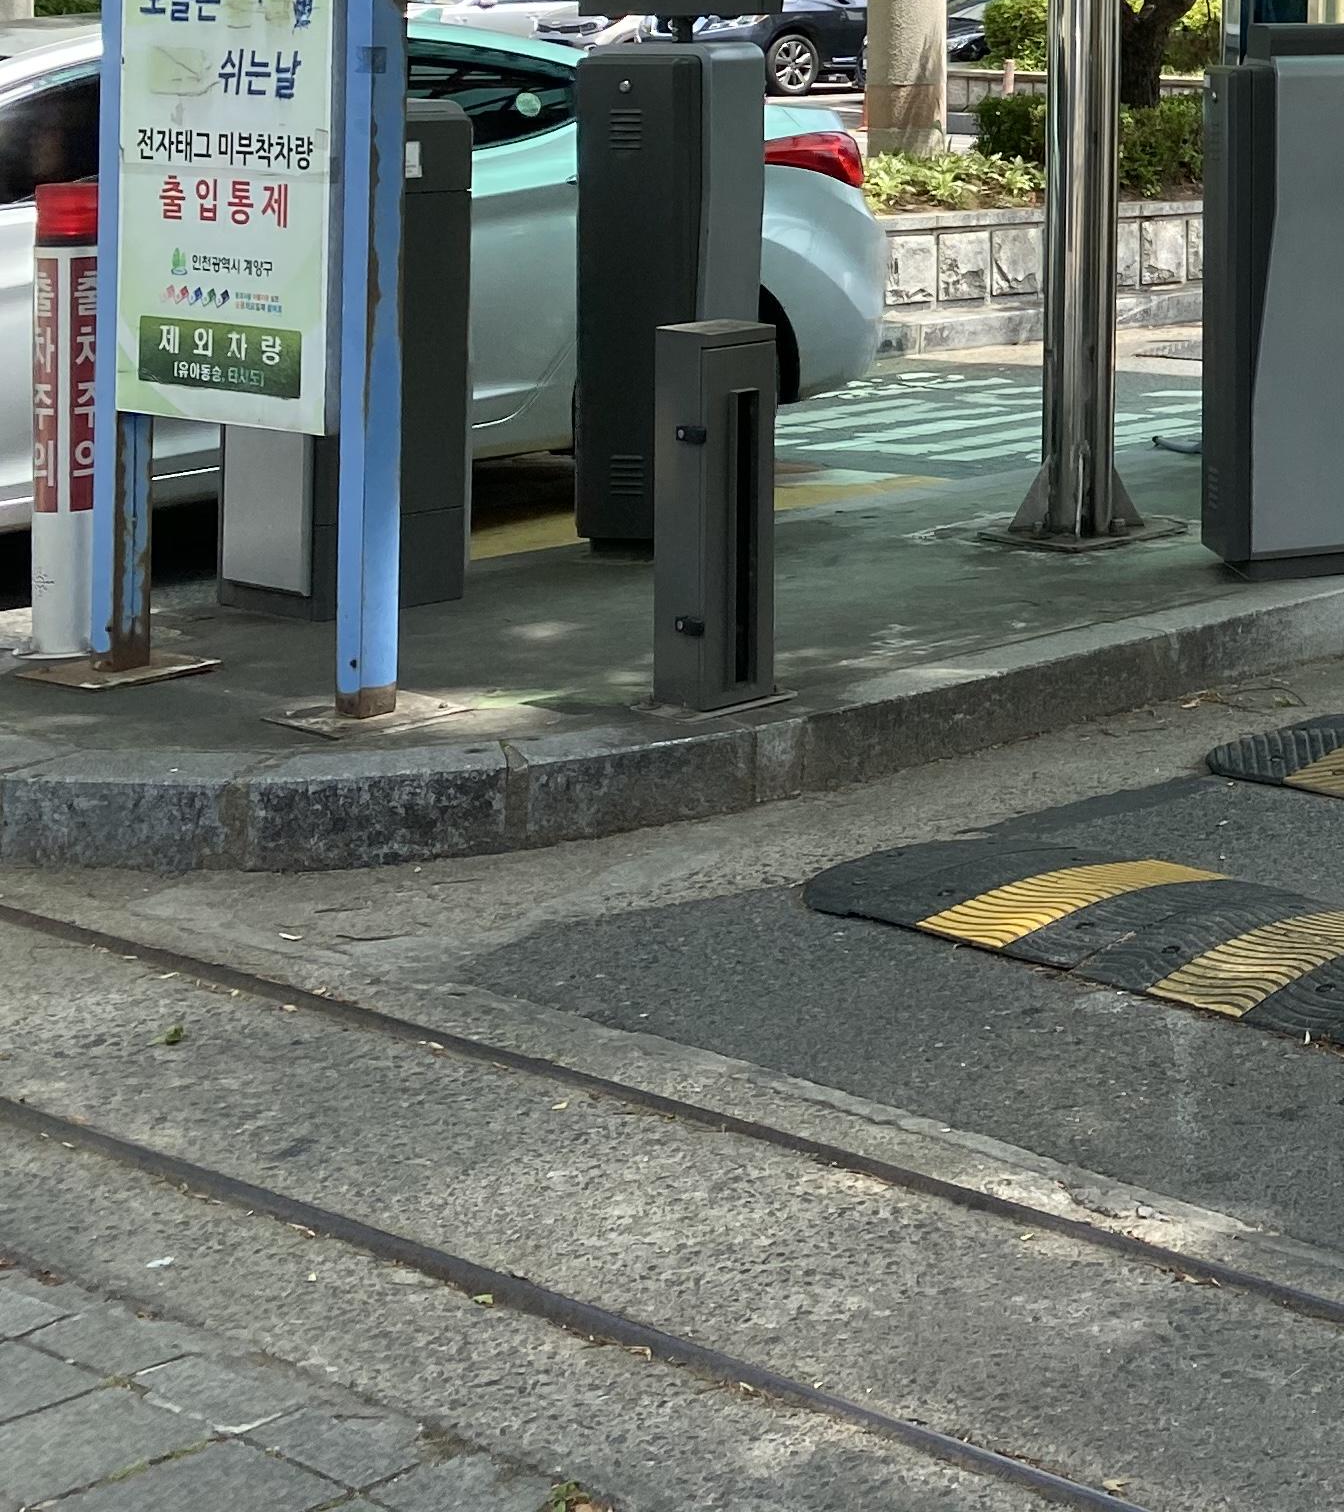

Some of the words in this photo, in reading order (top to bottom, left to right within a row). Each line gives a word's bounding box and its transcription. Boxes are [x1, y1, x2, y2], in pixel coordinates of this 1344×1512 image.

[218, 49, 301, 99] 쉬는날
[137, 128, 213, 162] 전자태그
[217, 131, 314, 171] 미부착차량
[191, 254, 240, 275] 인천광역시
[243, 258, 274, 278] 계양구
